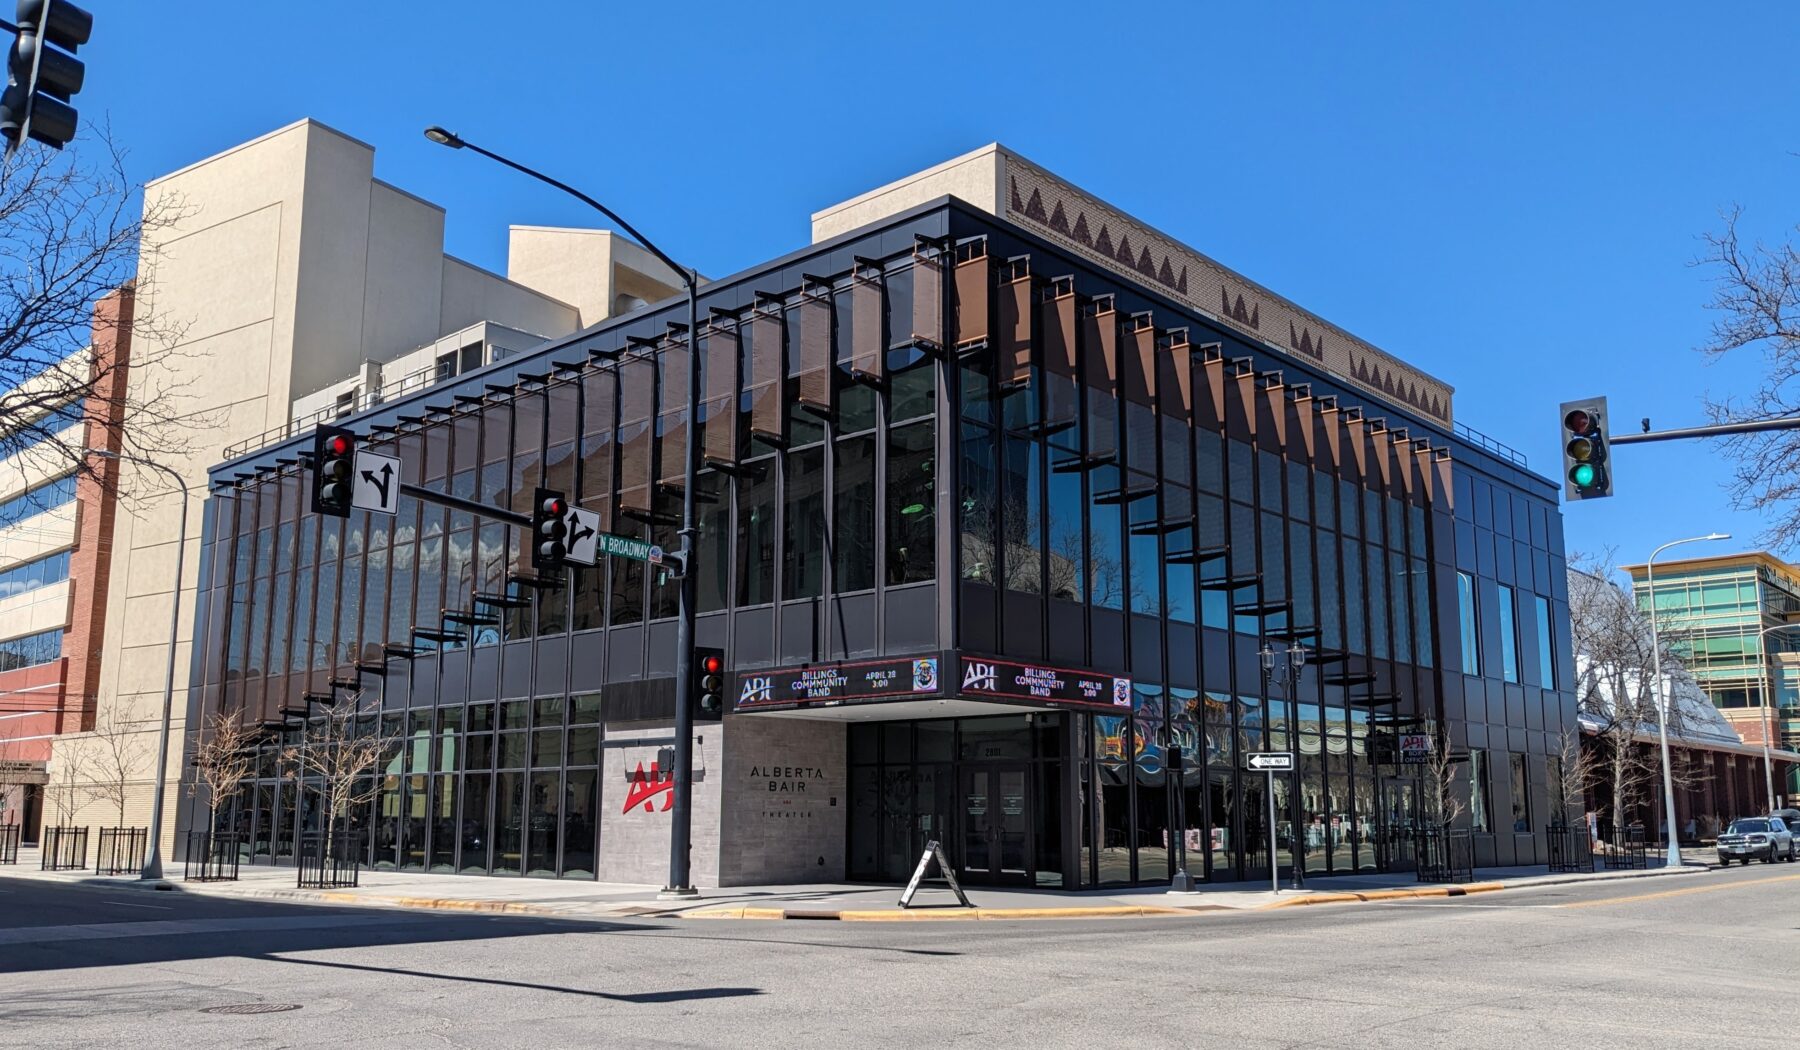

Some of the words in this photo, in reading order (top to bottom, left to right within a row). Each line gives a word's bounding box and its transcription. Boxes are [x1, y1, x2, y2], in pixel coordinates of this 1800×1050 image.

[600, 535, 607, 550] N
[608, 538, 650, 559] BROADWAY
[802, 669, 838, 681] BILLINGS
[866, 671, 887, 681] APRIL
[1024, 667, 1056, 680] BILLINGS
[872, 679, 888, 689] 3:00
[1078, 680, 1095, 690] APRIL
[807, 687, 831, 698] BAND
[1030, 686, 1051, 697] BAND
[750, 766, 823, 779] ALBERTA
[769, 781, 806, 792] BAIR
